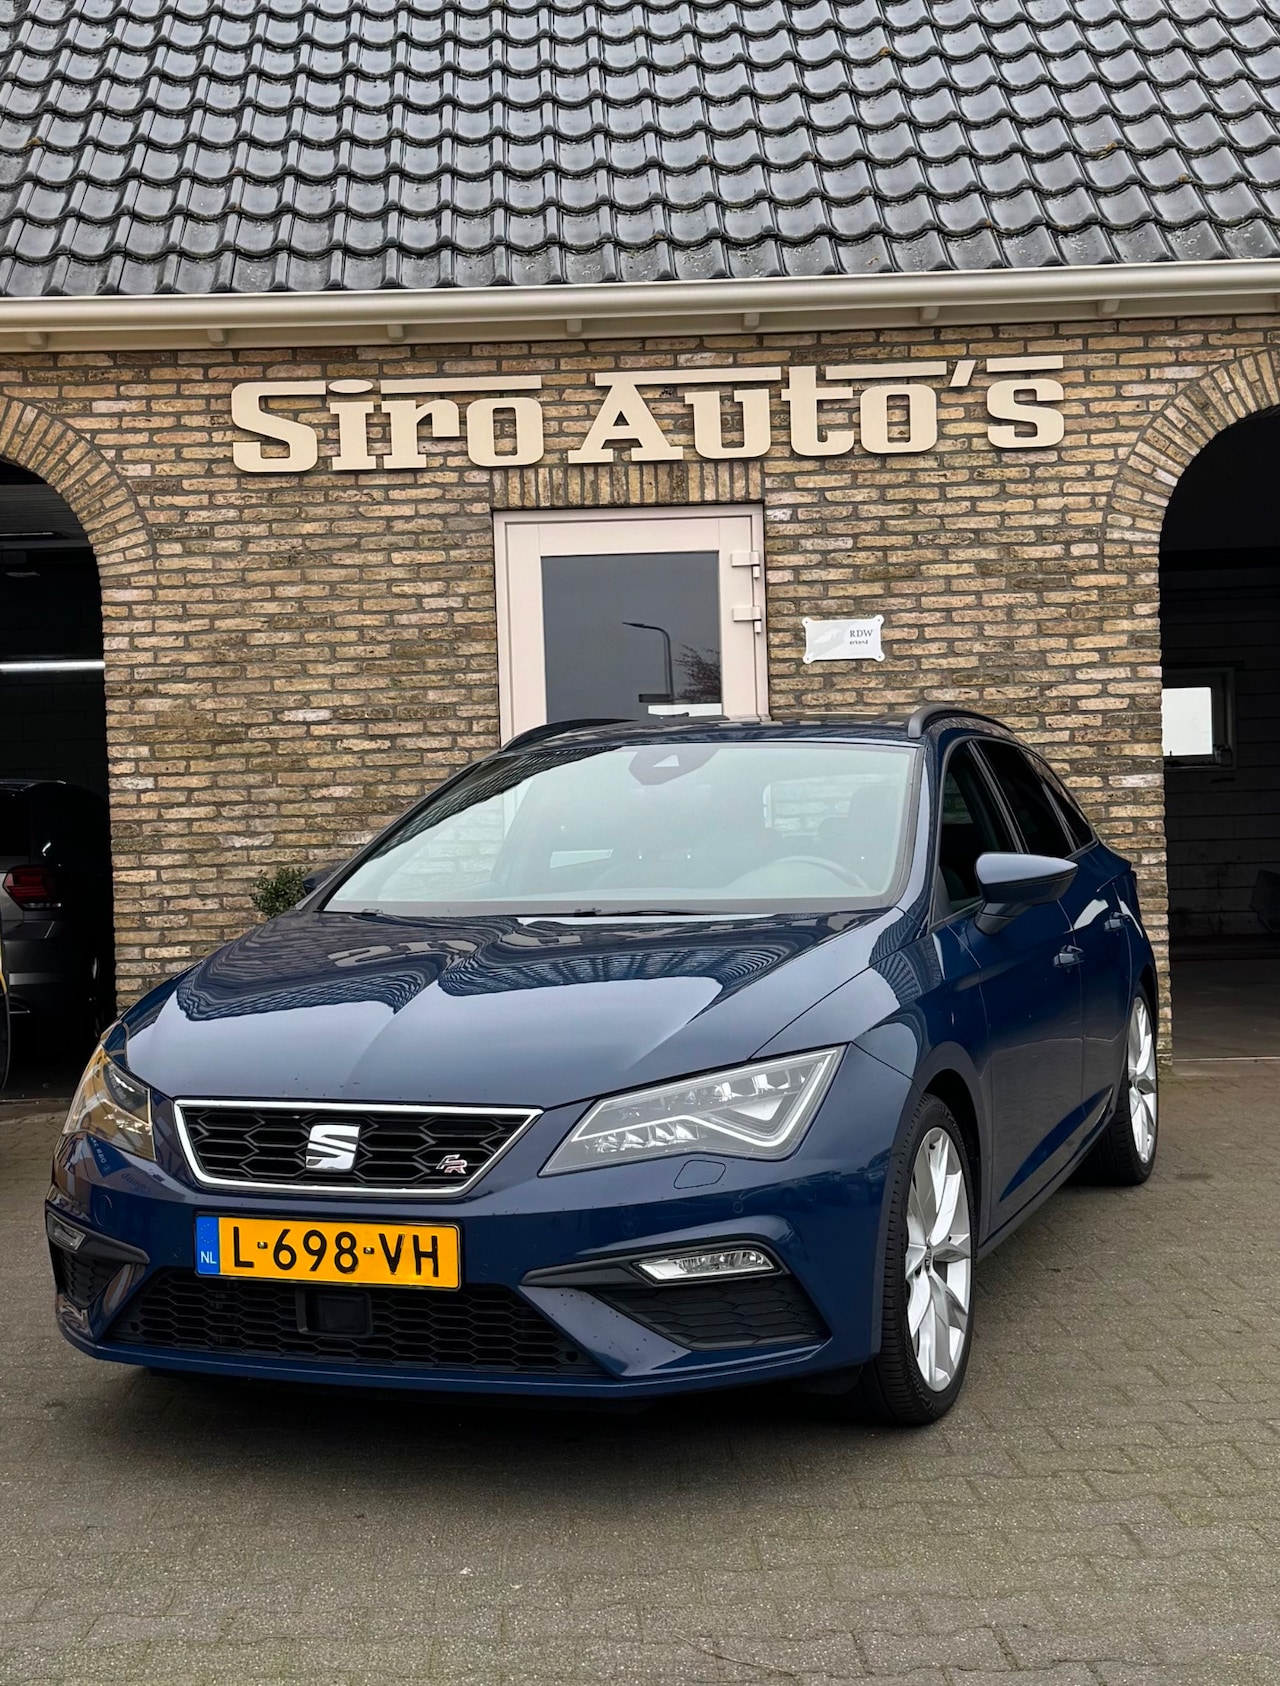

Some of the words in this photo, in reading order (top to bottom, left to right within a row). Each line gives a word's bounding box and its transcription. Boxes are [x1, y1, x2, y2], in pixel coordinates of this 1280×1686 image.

[231, 375, 544, 472] Siro
[567, 355, 1065, 464] Auto's
[849, 629, 873, 638] RDW
[200, 1250, 217, 1265] NL
[233, 1226, 440, 1278] L-698-VH
